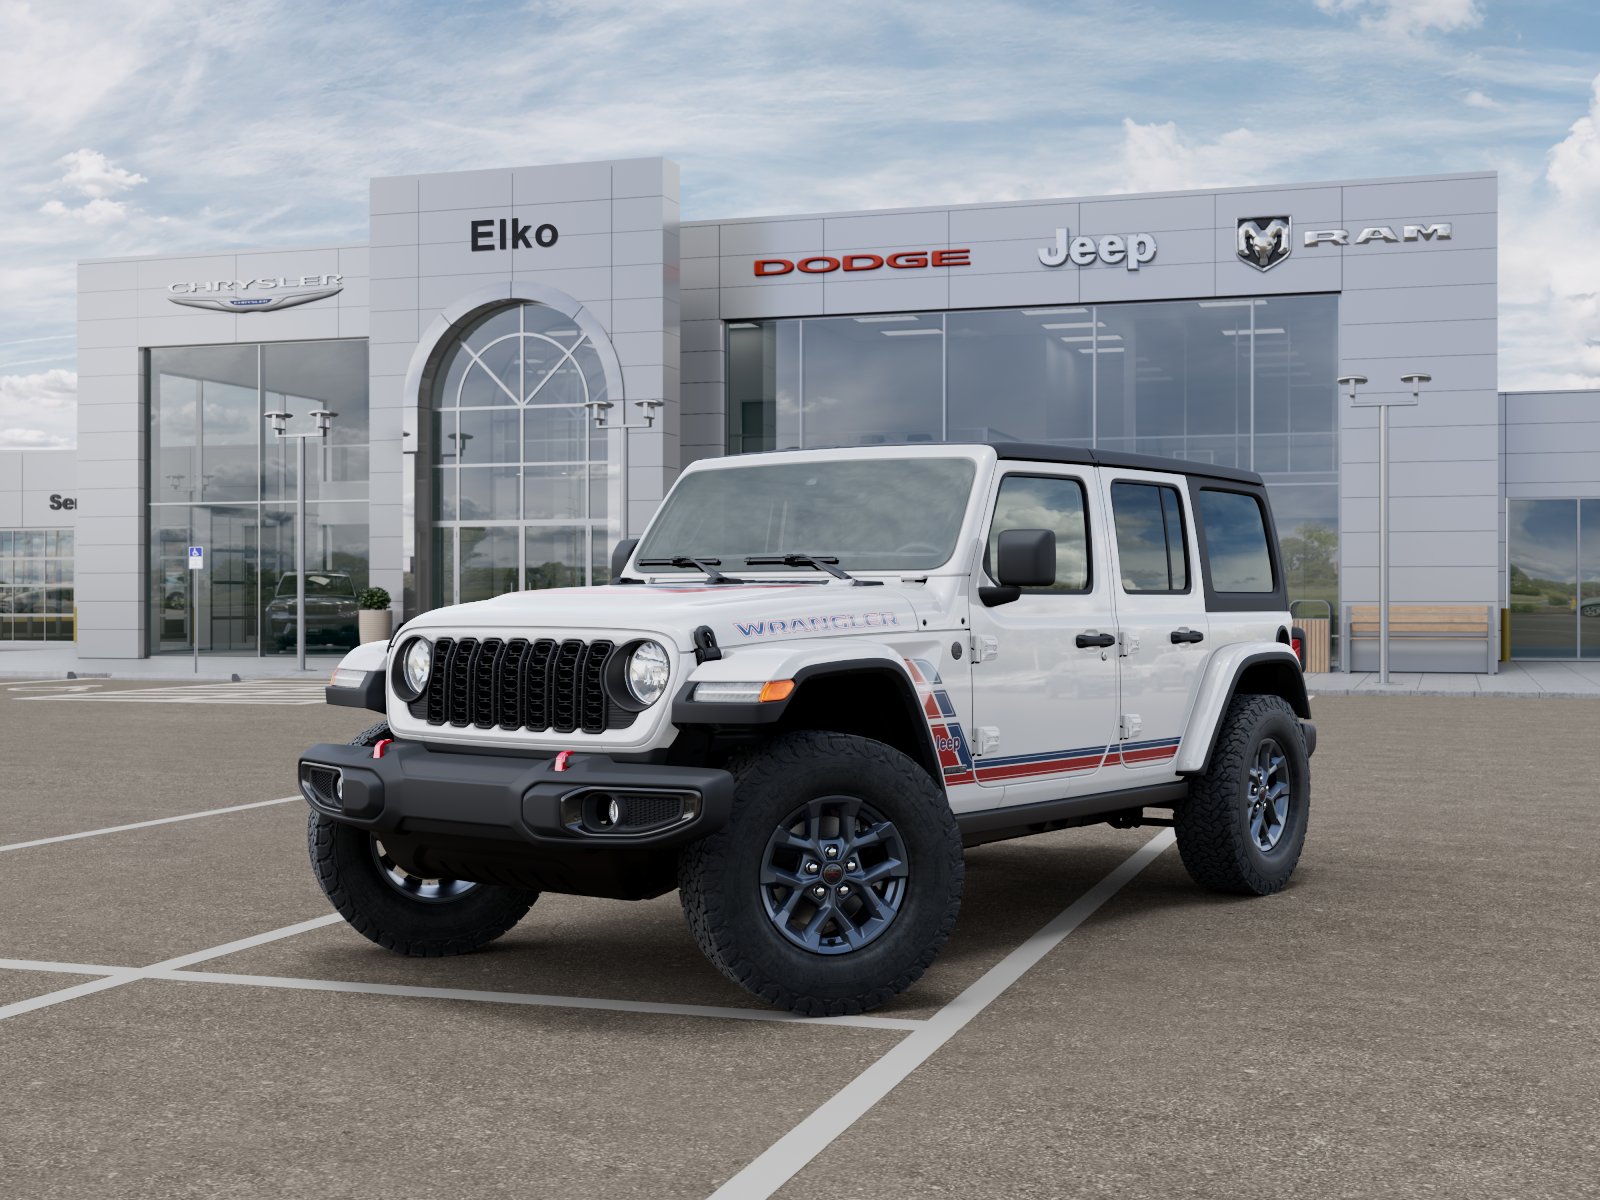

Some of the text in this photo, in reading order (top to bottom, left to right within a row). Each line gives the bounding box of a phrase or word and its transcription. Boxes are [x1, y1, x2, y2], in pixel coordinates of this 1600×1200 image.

[471, 218, 559, 252] Elko
[1304, 223, 1452, 248] RAM
[754, 249, 971, 277] DODGE
[1038, 227, 1157, 272] Jeep
[167, 274, 344, 294] CHRYSLER
[734, 611, 899, 637] WRANGLER
